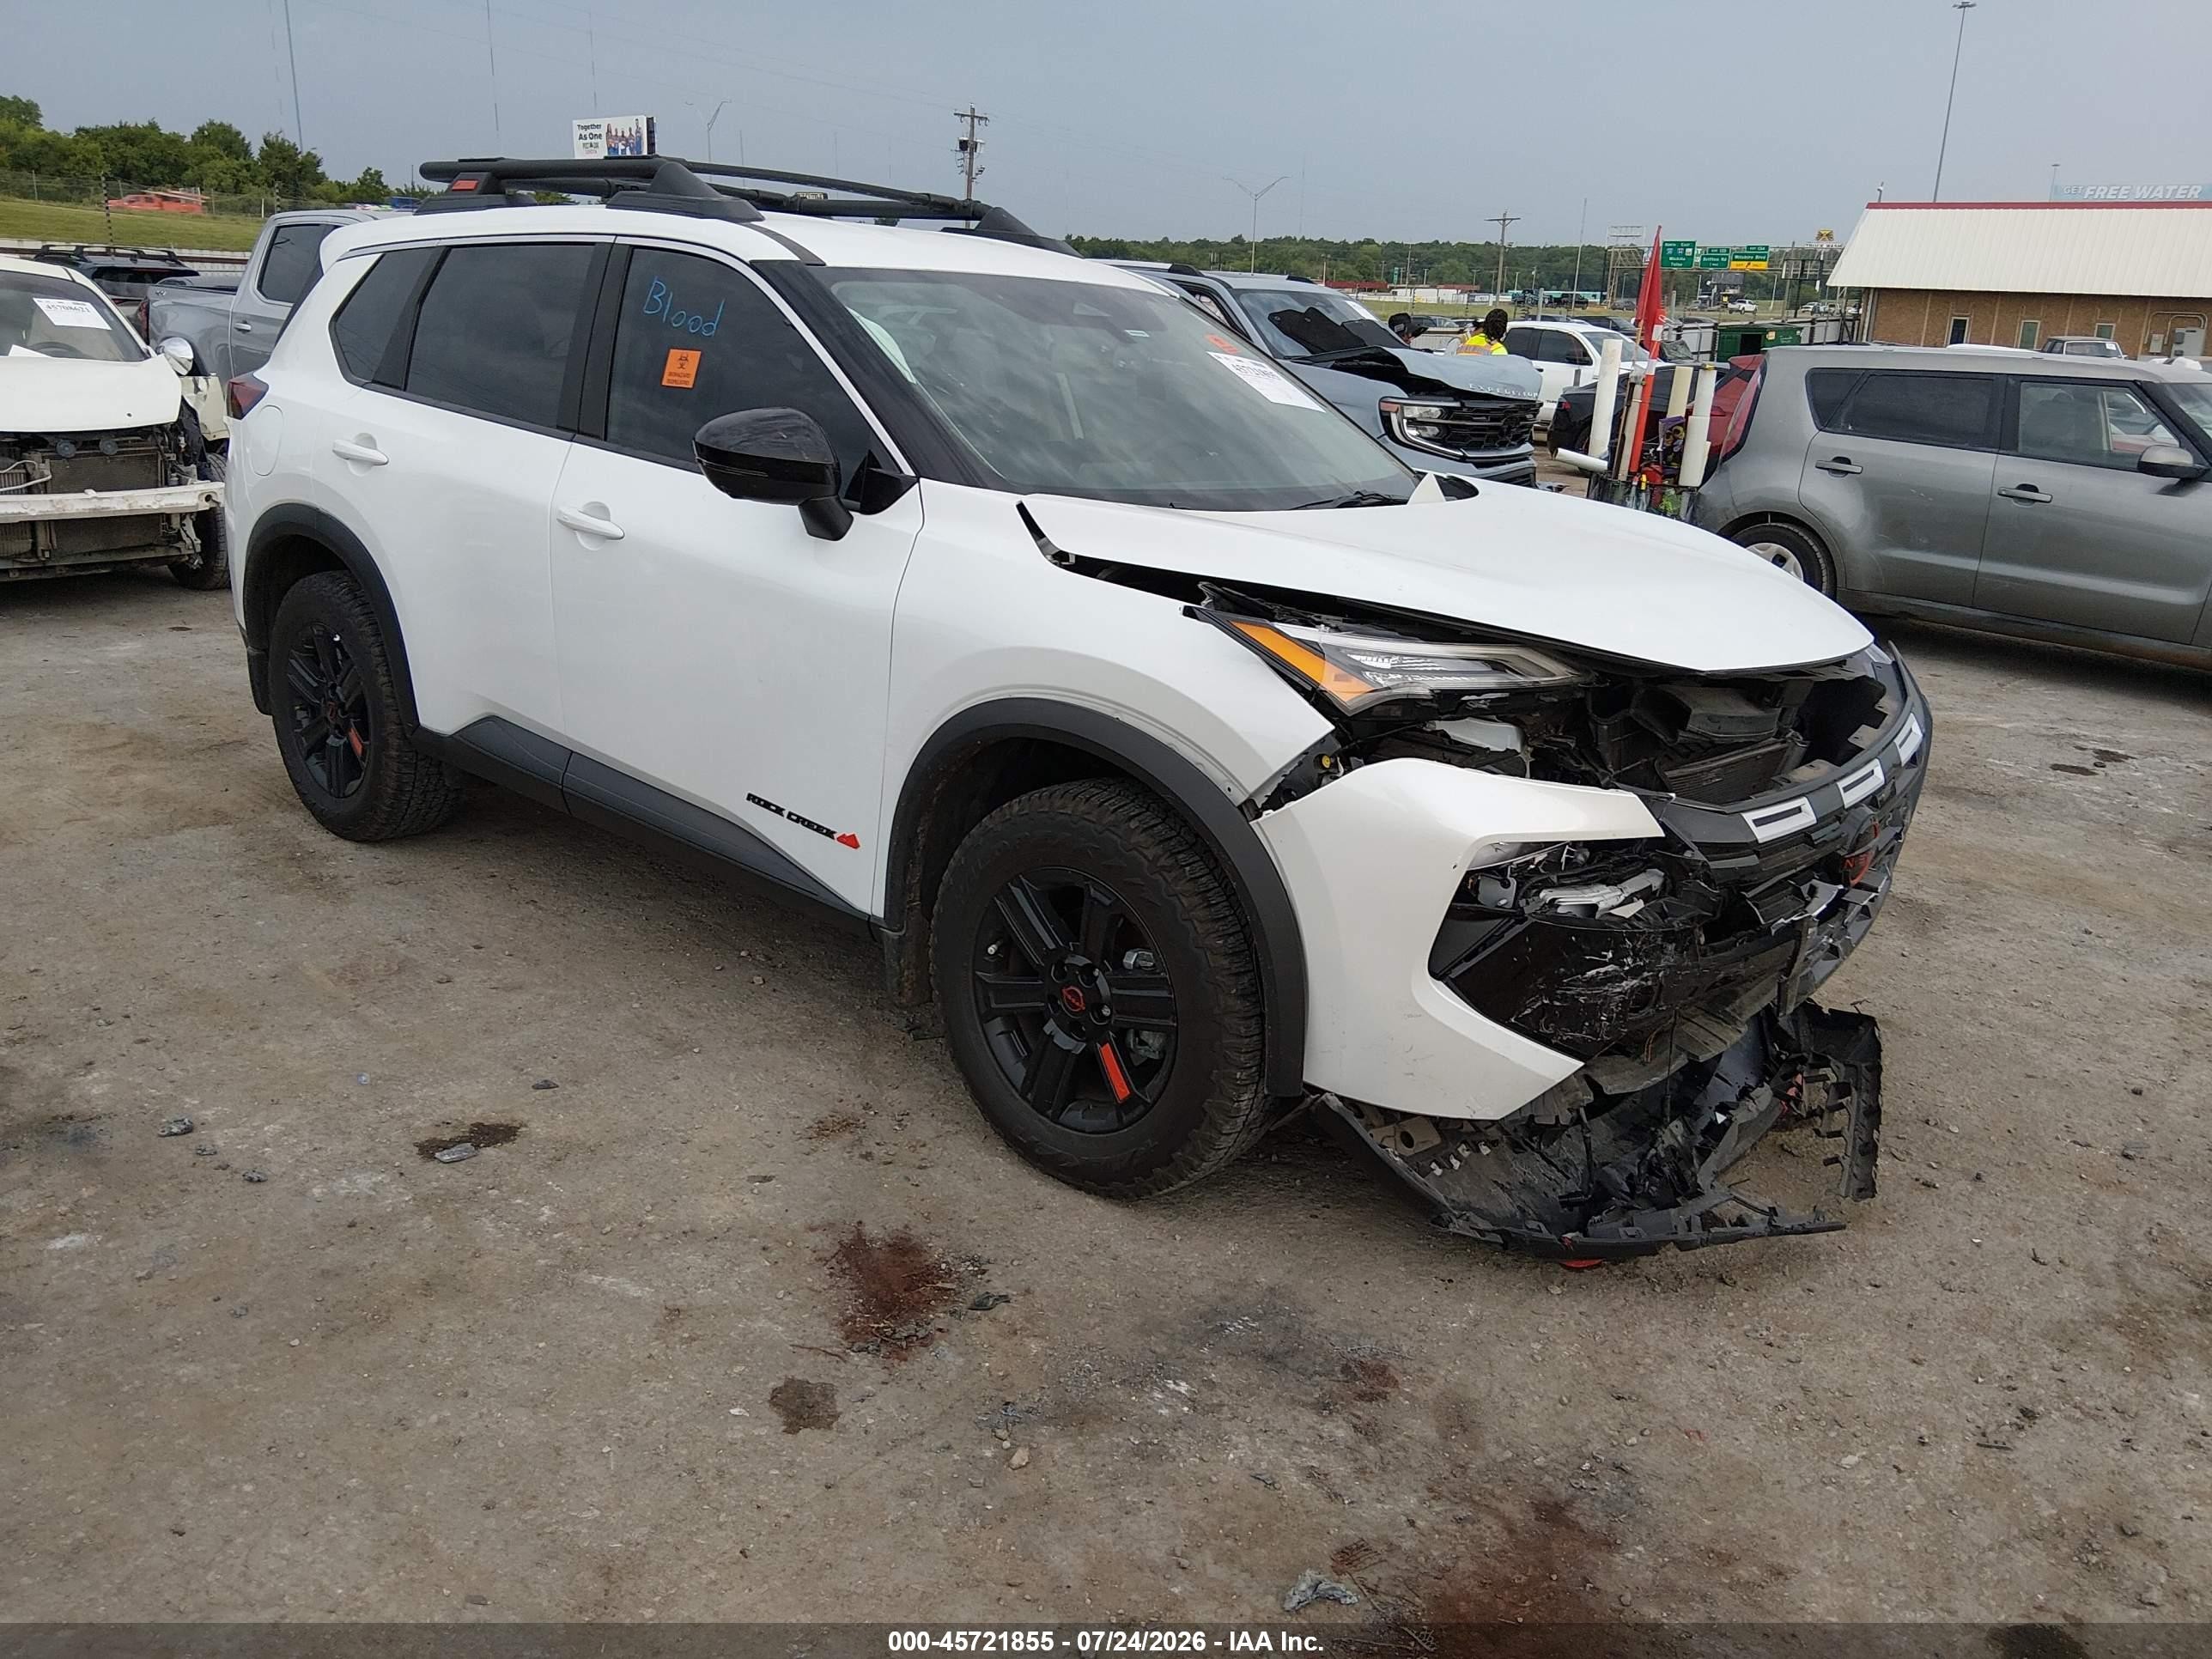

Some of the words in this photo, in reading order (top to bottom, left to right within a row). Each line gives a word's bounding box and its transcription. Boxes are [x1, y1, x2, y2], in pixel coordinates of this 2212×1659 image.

[2063, 185, 2083, 194] GET
[2084, 185, 2131, 199] FREE
[2133, 185, 2202, 199] WATER
[643, 276, 726, 337] Blood
[745, 793, 787, 817] ROCK
[786, 811, 838, 841] CREEK
